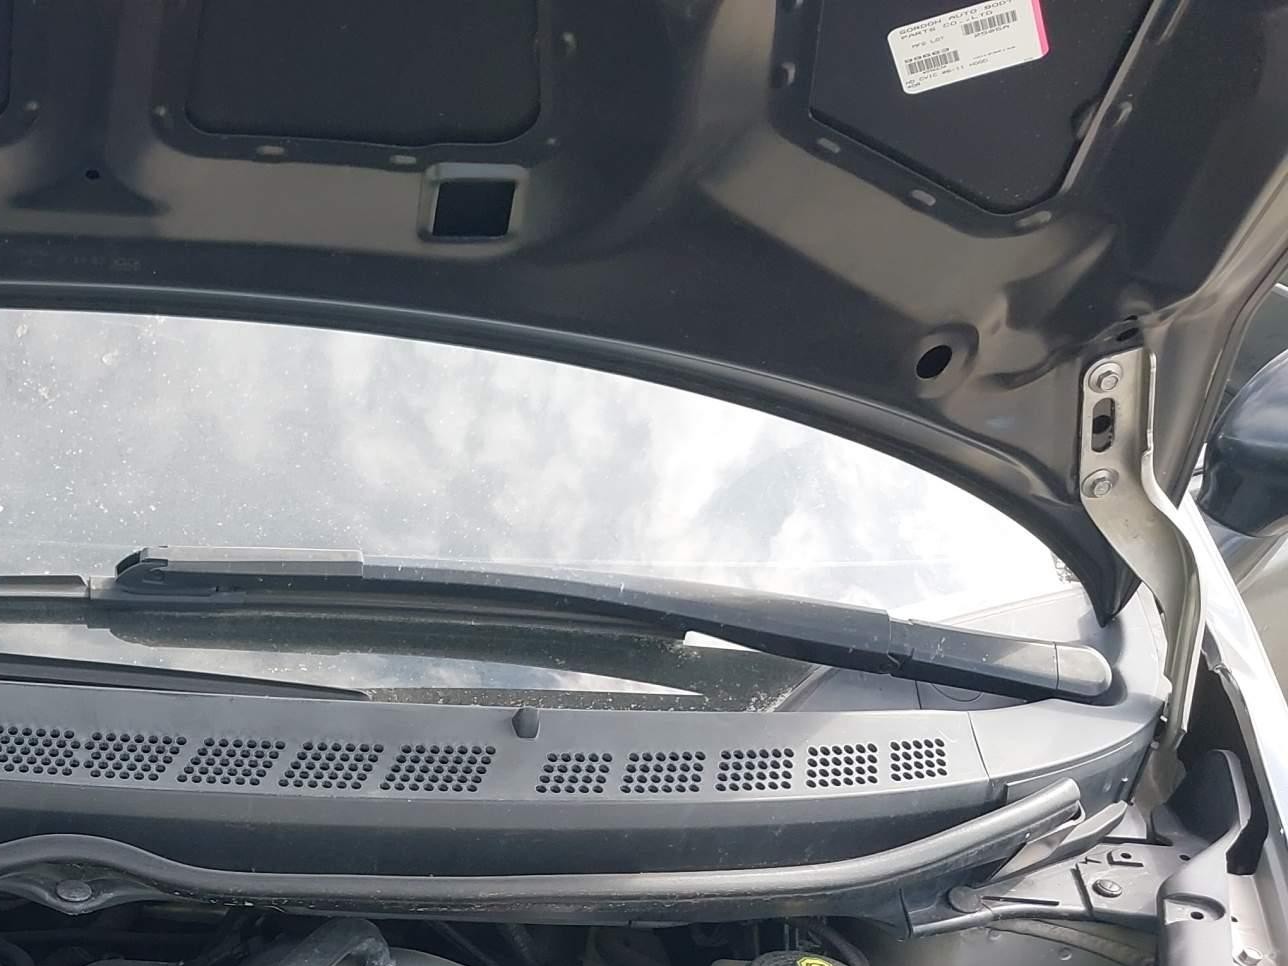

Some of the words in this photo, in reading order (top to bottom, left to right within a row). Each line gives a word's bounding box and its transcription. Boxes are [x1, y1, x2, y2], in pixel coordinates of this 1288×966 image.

[899, 19, 941, 35] GORDON
[948, 9, 977, 20] AUTO
[900, 27, 936, 39] PARTS
